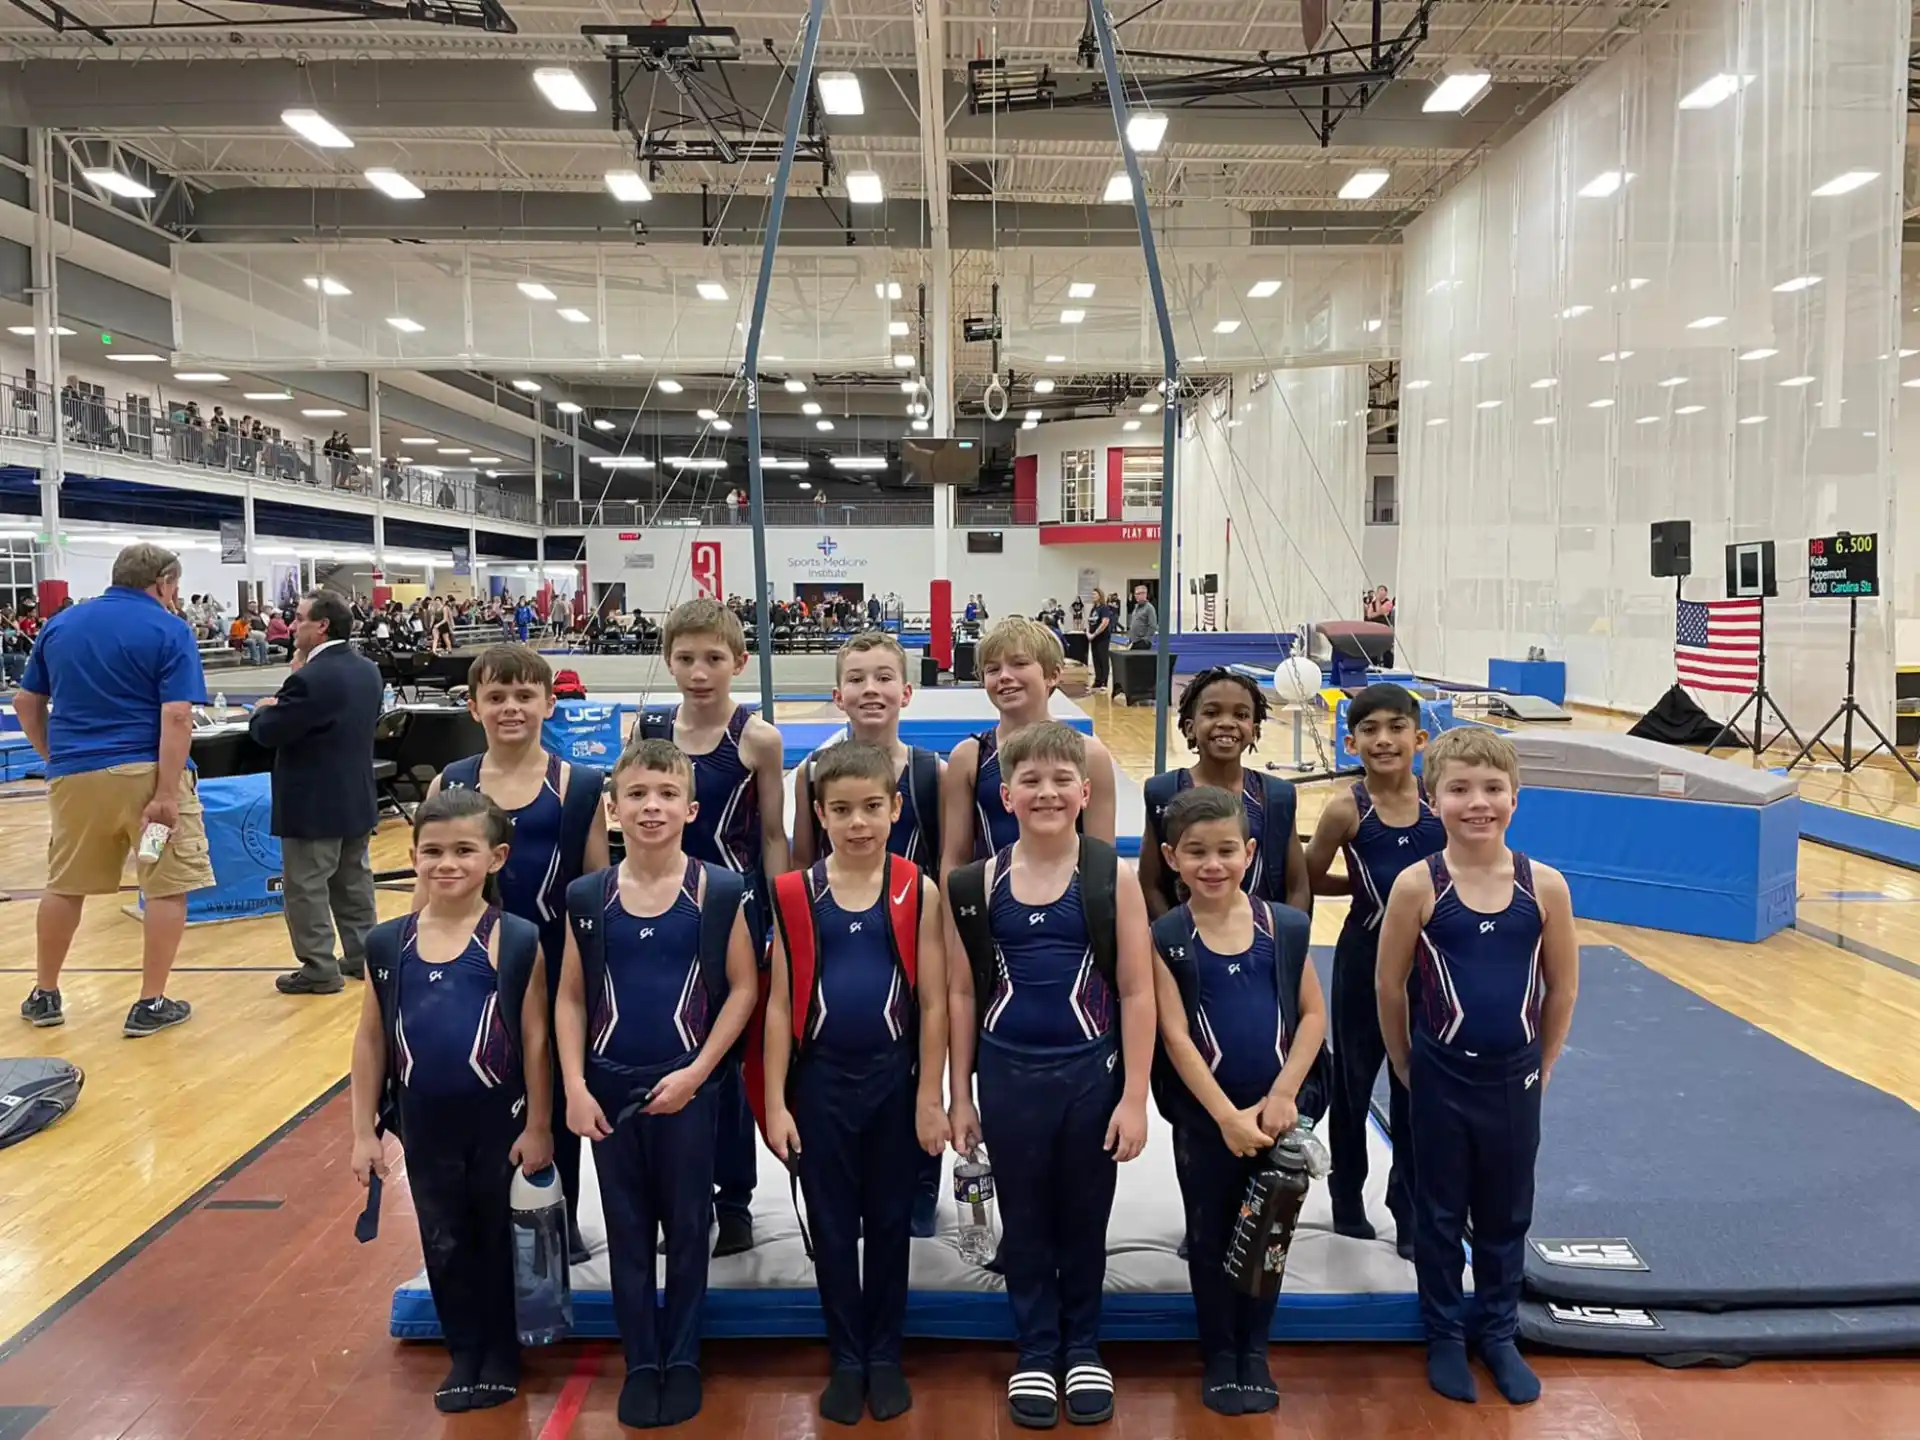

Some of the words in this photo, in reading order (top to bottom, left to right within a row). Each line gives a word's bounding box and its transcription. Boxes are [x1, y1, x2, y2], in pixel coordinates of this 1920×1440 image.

[1122, 527, 1142, 538] PLAY
[1811, 540, 1824, 554] HB
[1836, 536, 1872, 554] 6.500
[787, 557, 820, 568] Sports
[824, 556, 867, 567] Medicine
[1811, 556, 1828, 566] Kobe
[808, 569, 847, 578] Institute
[1831, 580, 1859, 593] Carolina
